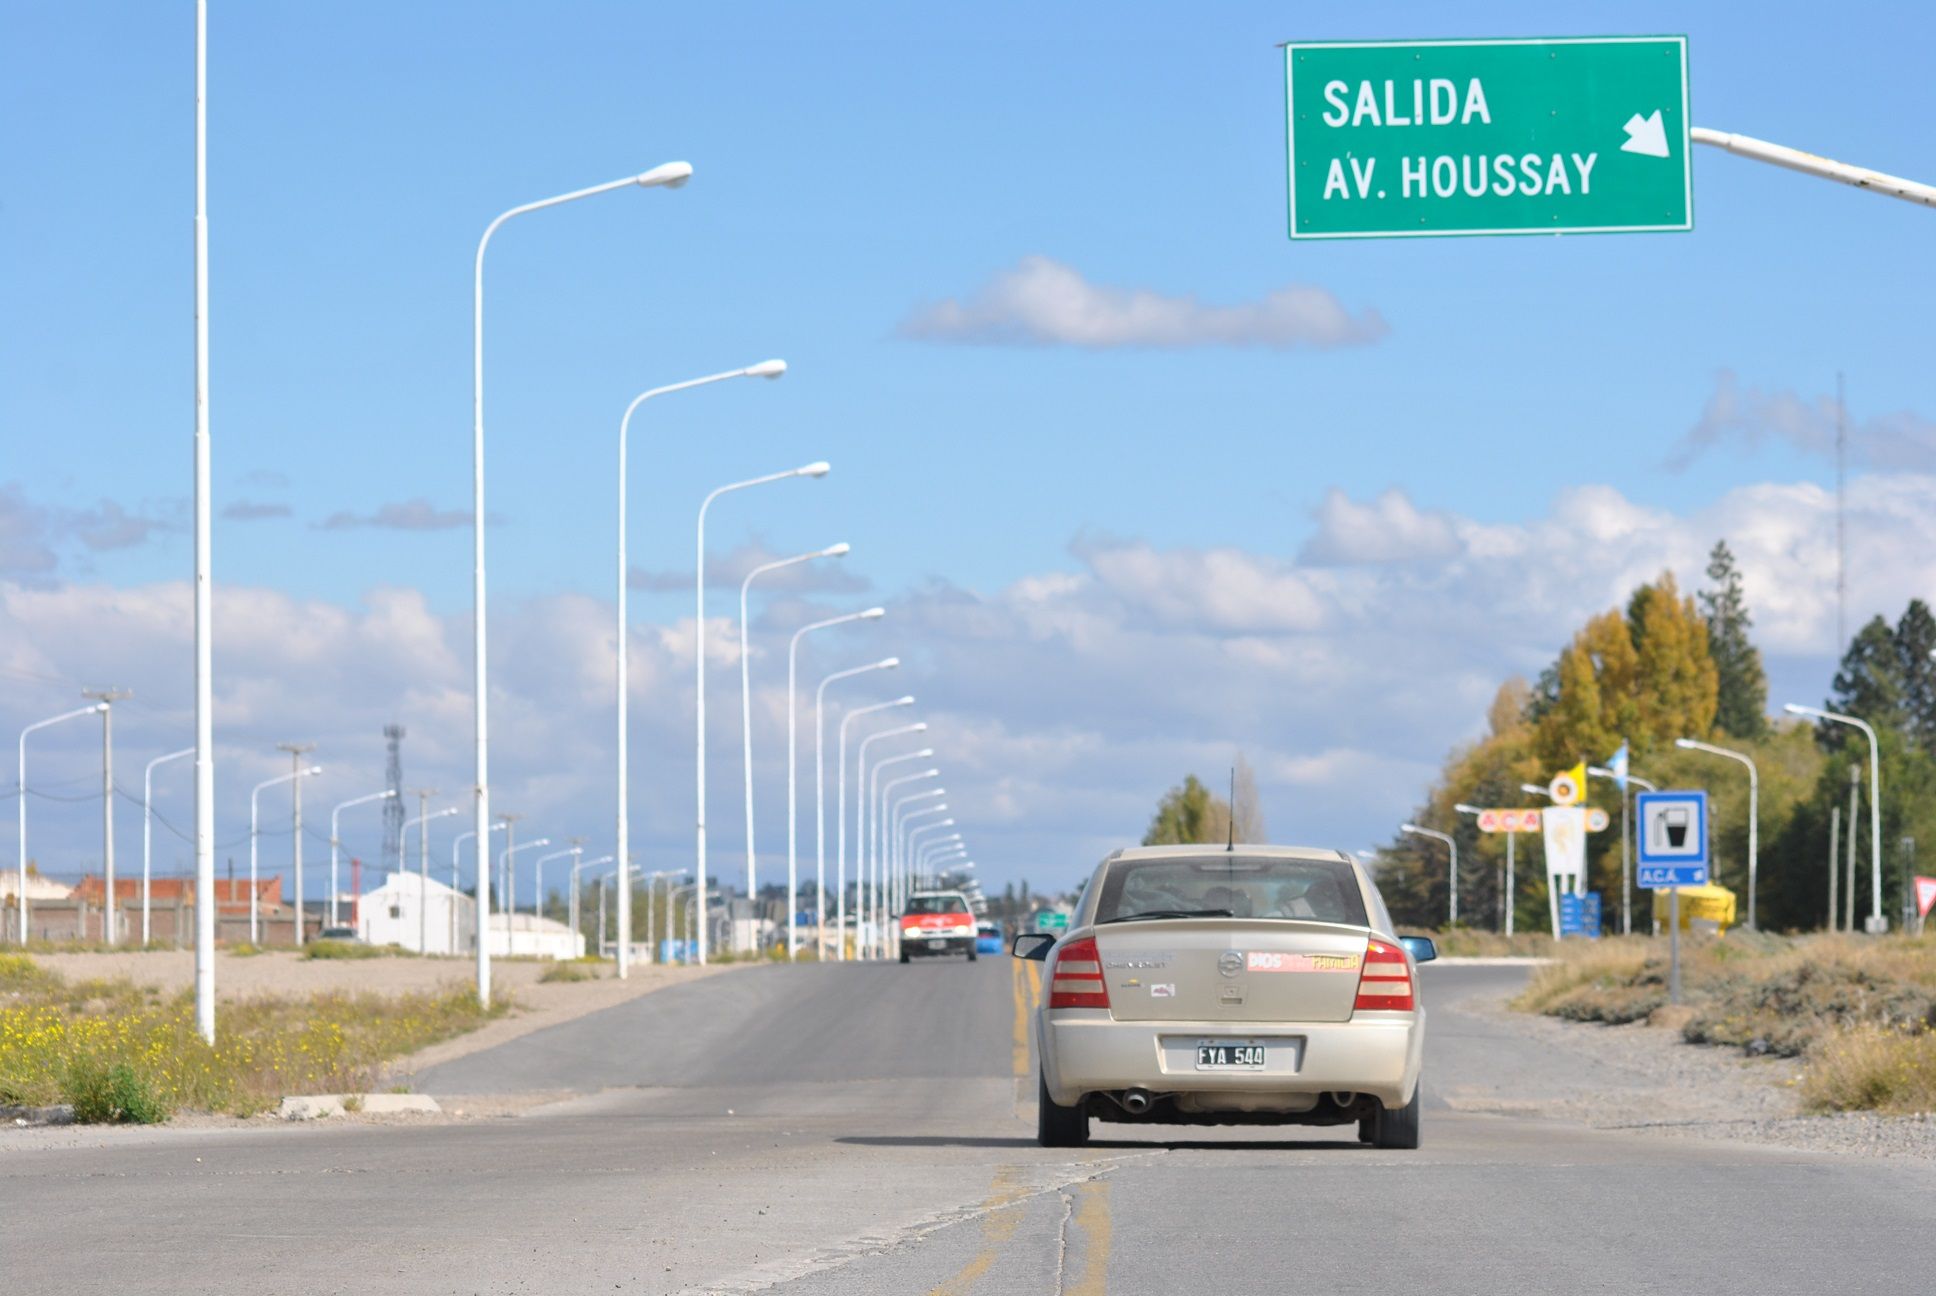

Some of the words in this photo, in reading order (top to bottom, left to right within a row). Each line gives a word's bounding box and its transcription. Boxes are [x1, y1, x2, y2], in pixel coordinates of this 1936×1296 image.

[1322, 77, 1491, 128] SALIDA
[1323, 156, 1386, 200] AV.
[1402, 152, 1598, 199] HOUSSAY
[1198, 1047, 1227, 1065] FYA
[1234, 1047, 1263, 1065] 544
